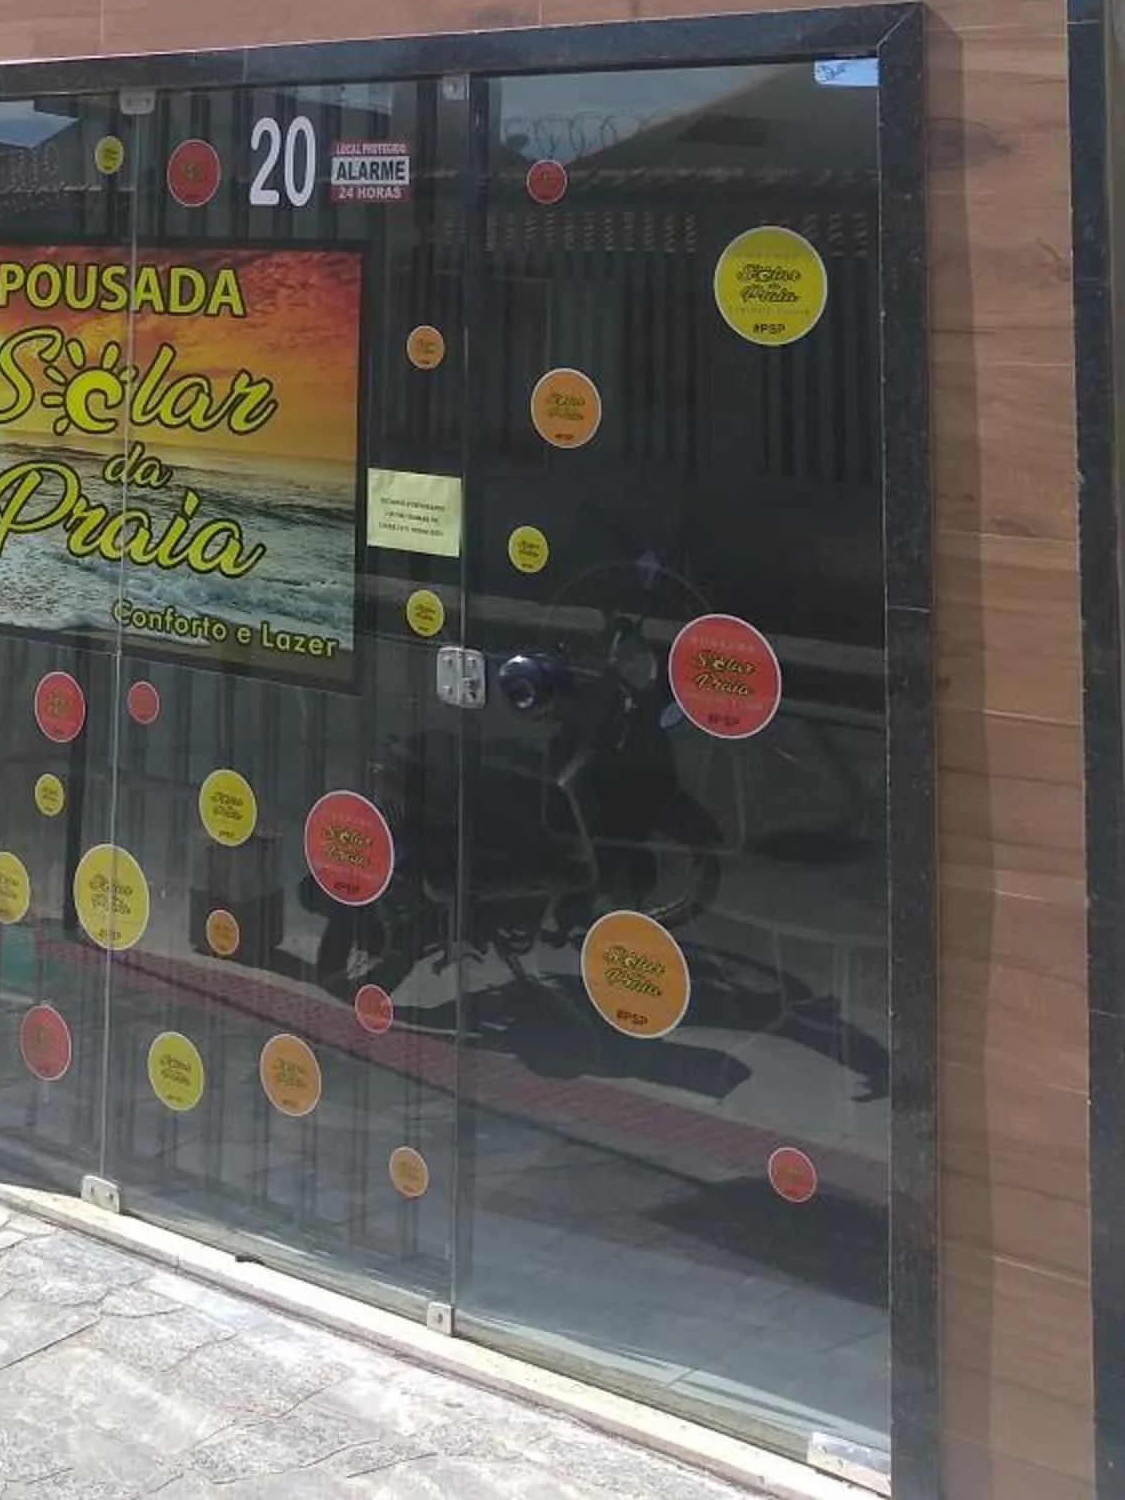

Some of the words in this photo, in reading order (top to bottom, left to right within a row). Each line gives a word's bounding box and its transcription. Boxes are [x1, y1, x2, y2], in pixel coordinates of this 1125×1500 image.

[249, 115, 316, 207] 20
[336, 160, 406, 181] ALARME
[338, 187, 355, 199] 24
[358, 187, 402, 200] HORAS
[103, 442, 172, 489] da
[112, 600, 228, 643] Conforto
[235, 624, 252, 645] e
[260, 622, 340, 659] Lazer
